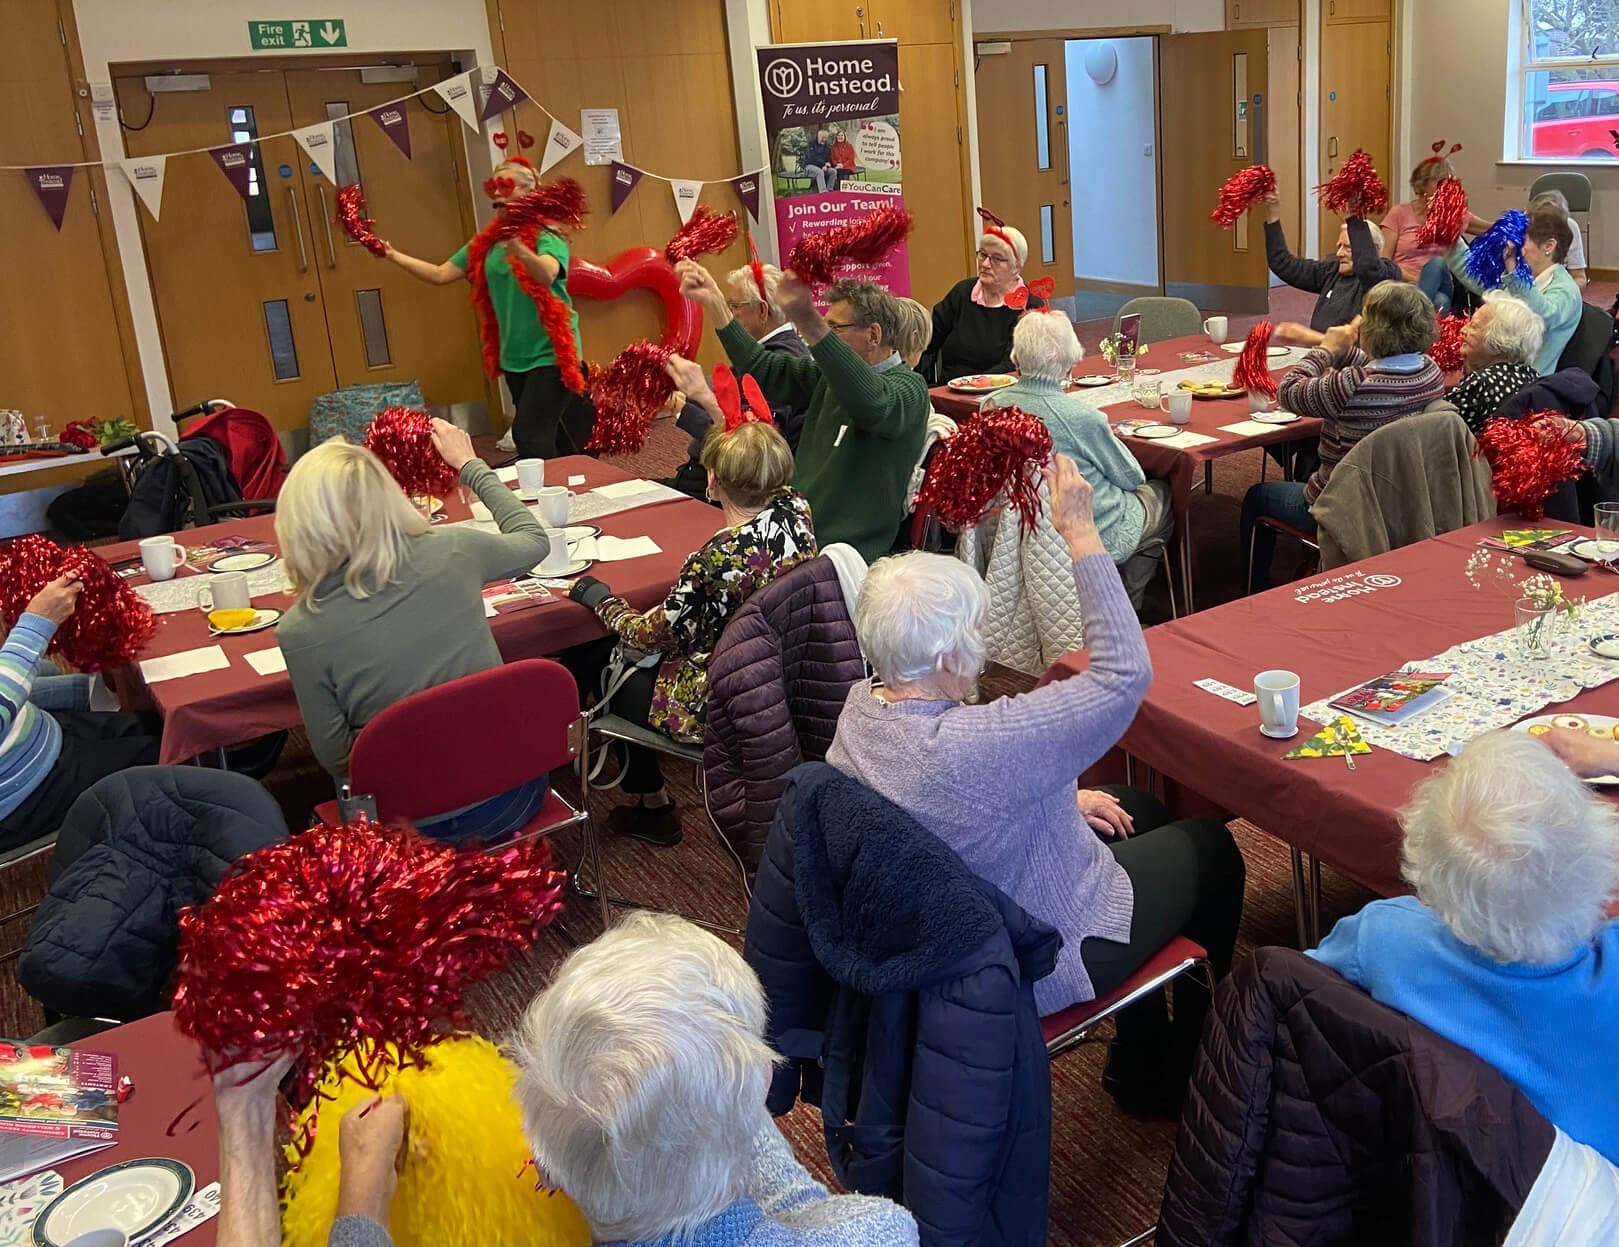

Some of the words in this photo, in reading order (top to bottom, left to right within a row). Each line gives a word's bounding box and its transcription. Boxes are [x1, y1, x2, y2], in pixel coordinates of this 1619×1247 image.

[258, 24, 283, 34] Fire
[261, 36, 285, 46] exit
[806, 57, 873, 76] Home
[782, 103, 796, 119] To
[824, 96, 880, 119] personal
[841, 182, 901, 194] #YouCanCare
[788, 204, 816, 218] Join
[820, 201, 847, 213] Our
[851, 197, 894, 211] Team!
[802, 217, 848, 229] Rewarding
[1295, 581, 1364, 604] Instead
[1321, 585, 1379, 604] Home
[183, 1204, 206, 1220] 439
